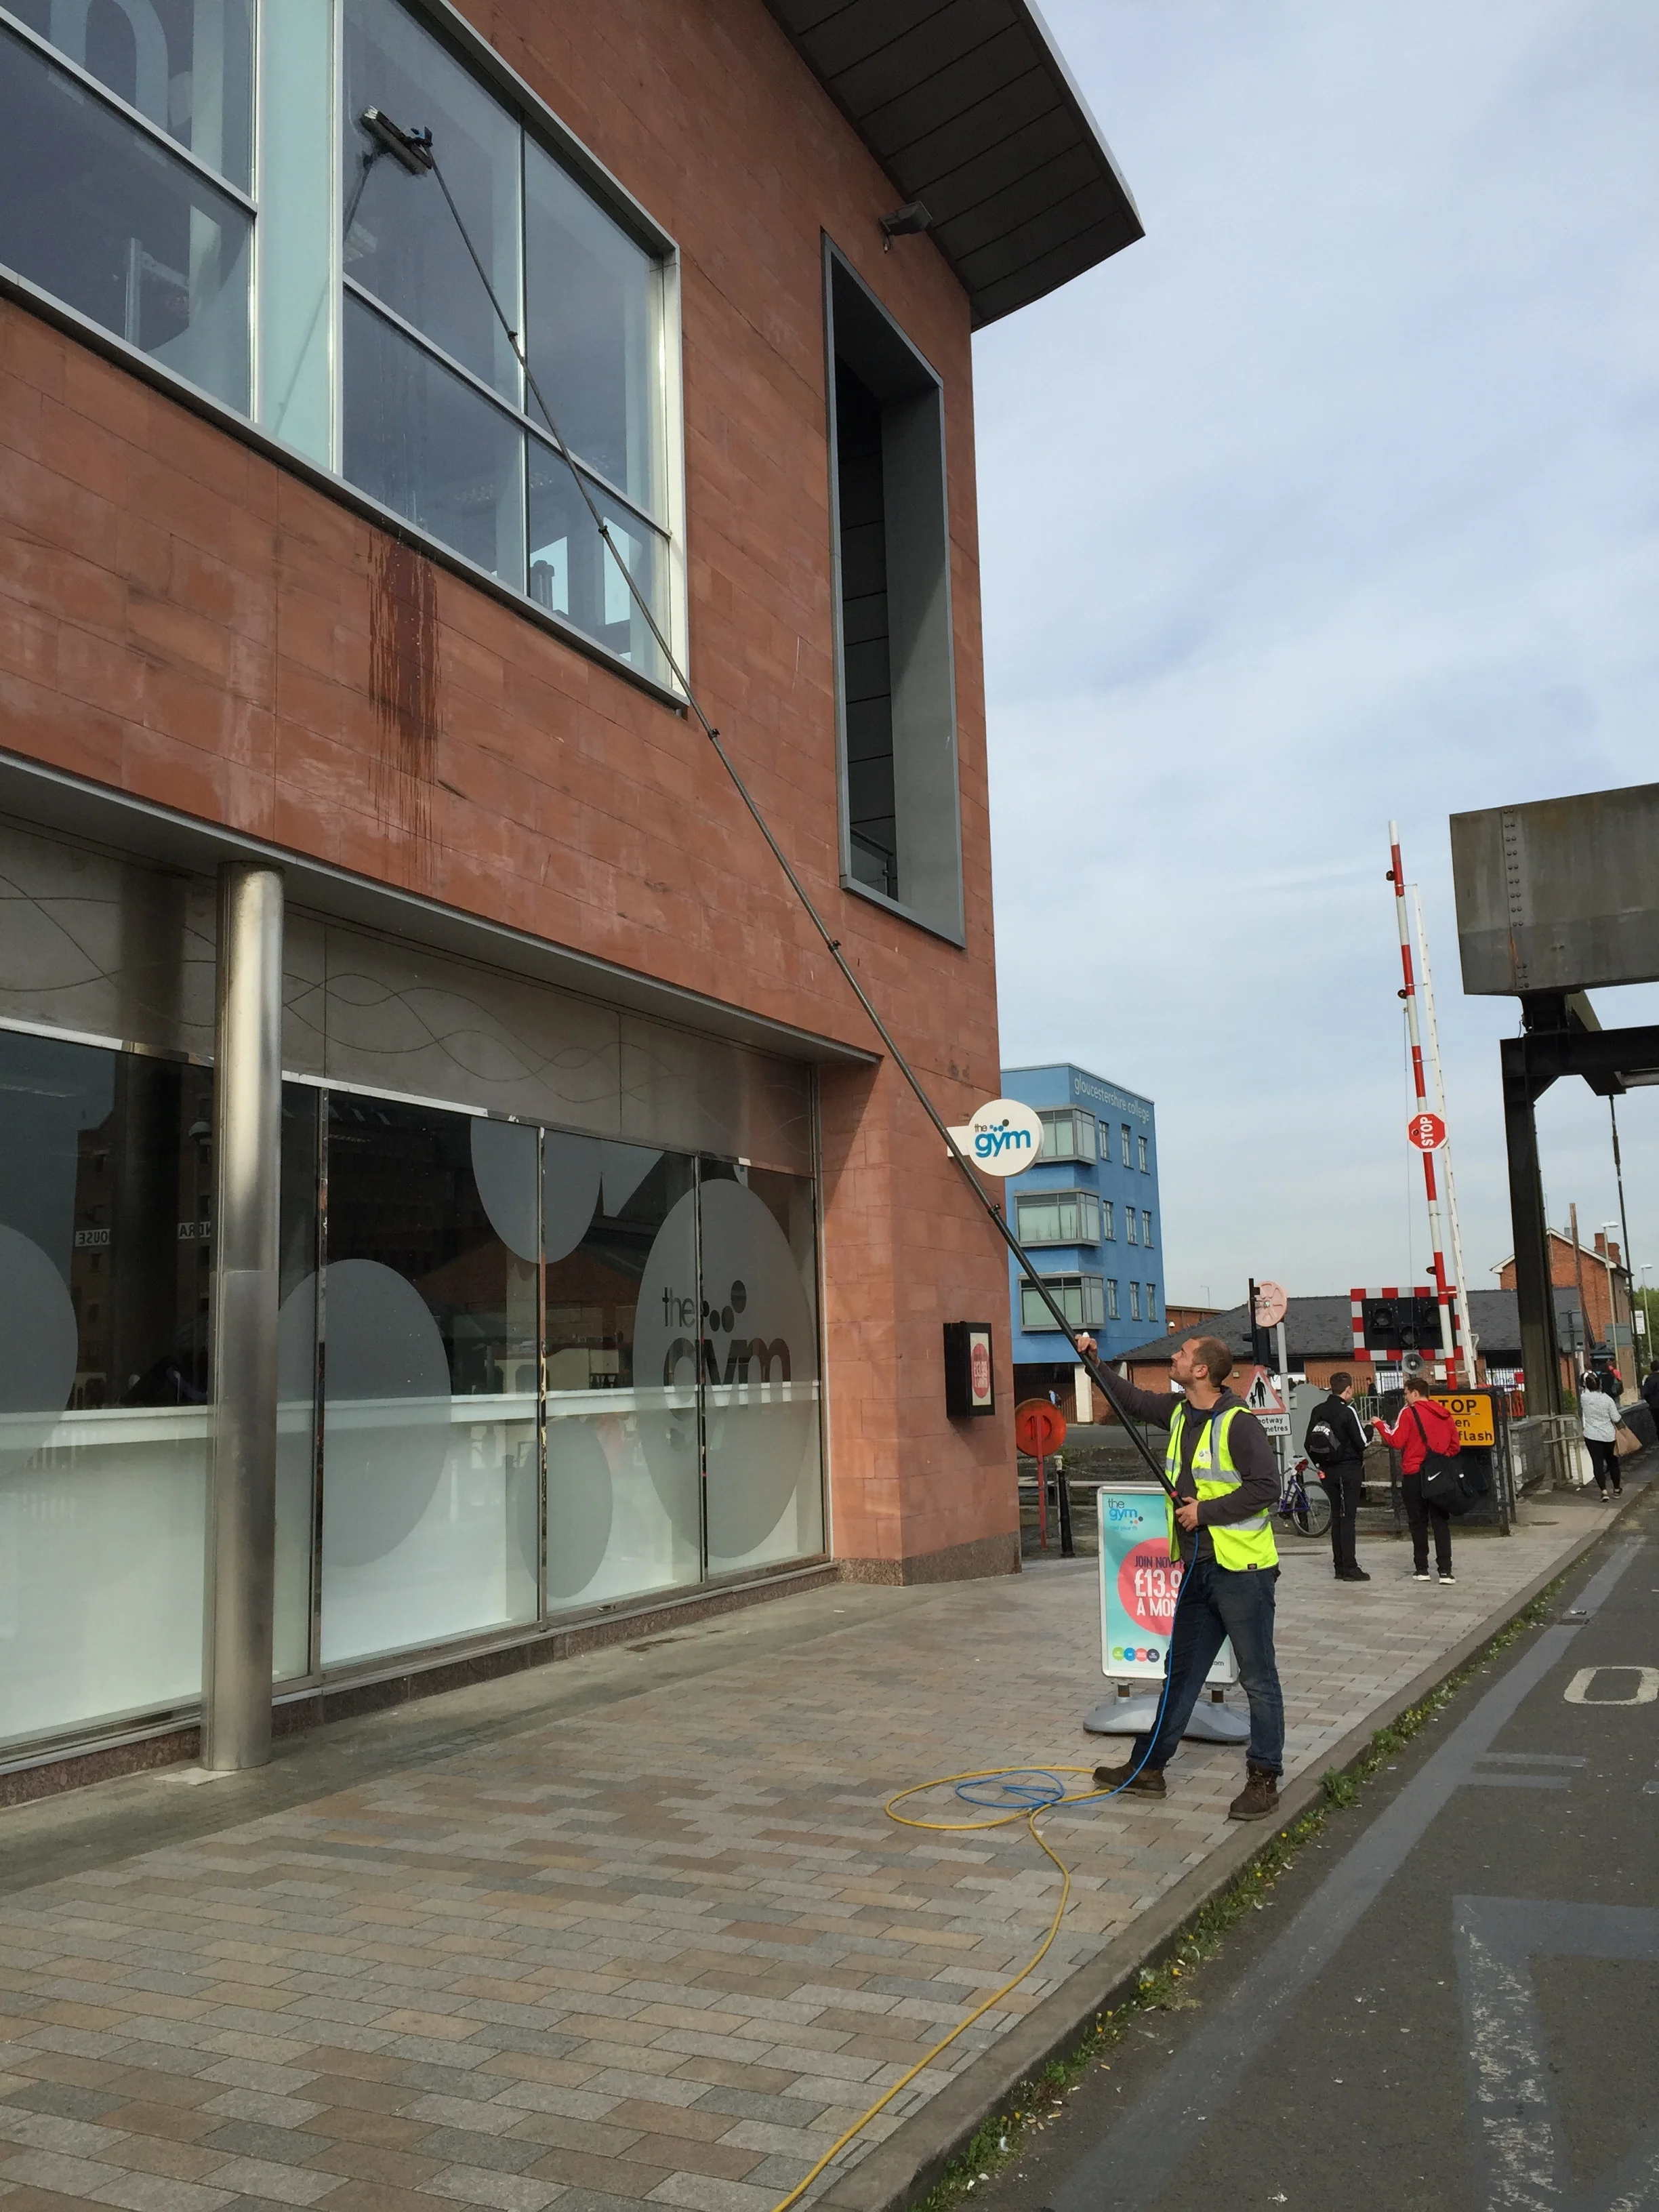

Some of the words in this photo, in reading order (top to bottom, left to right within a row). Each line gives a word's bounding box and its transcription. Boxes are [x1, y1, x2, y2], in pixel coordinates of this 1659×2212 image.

[1074, 1073, 1126, 1111] gloucestershire
[1128, 1100, 1150, 1124] college
[975, 1124, 987, 1132] the
[1420, 1116, 1434, 1146] STOP
[975, 1130, 1031, 1158] gym
[662, 1287, 695, 1328] the
[1430, 1399, 1477, 1413] TOP
[1455, 1419, 1471, 1427] en
[1459, 1431, 1493, 1441] flash
[1108, 1498, 1125, 1509] the
[1109, 1508, 1138, 1521] gym
[1135, 1555, 1153, 1568] JOIN
[1134, 1569, 1183, 1598] £13.9
[1136, 1597, 1146, 1616] A
[1149, 1597, 1176, 1617] MON
